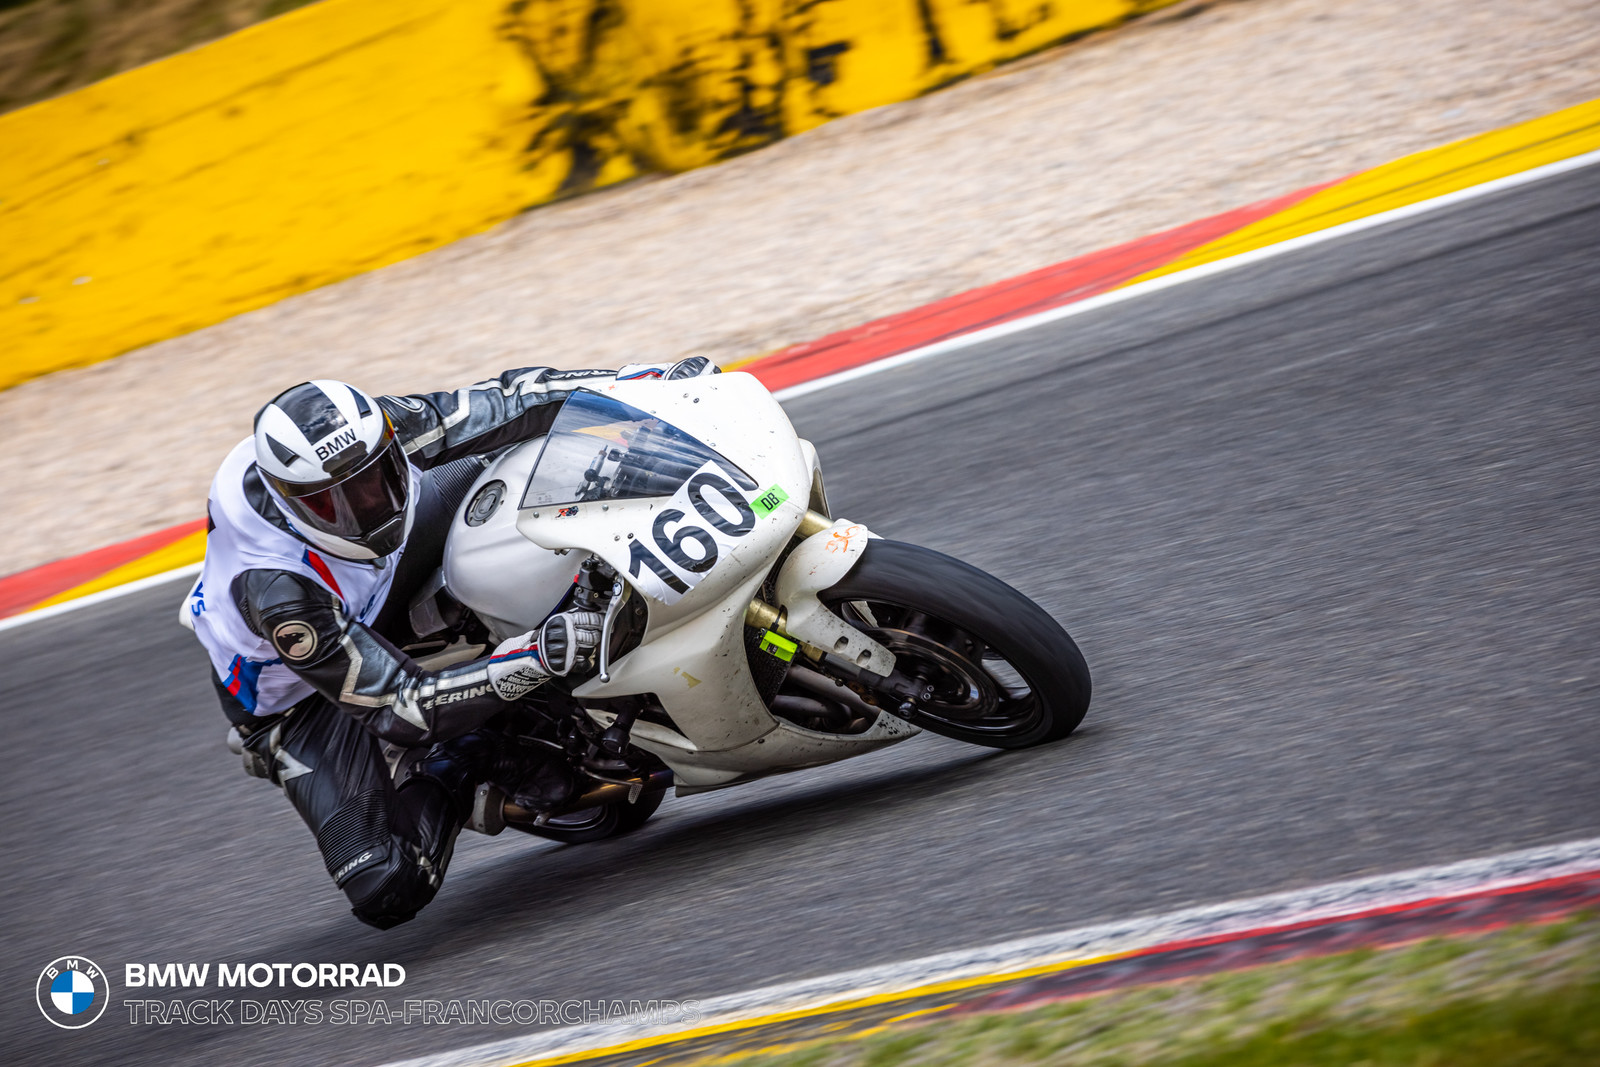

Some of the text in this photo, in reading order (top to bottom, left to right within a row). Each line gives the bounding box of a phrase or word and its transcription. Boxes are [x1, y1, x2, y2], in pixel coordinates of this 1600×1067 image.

[315, 428, 357, 461] BMW
[760, 492, 780, 511] DB
[628, 472, 756, 595] 160
